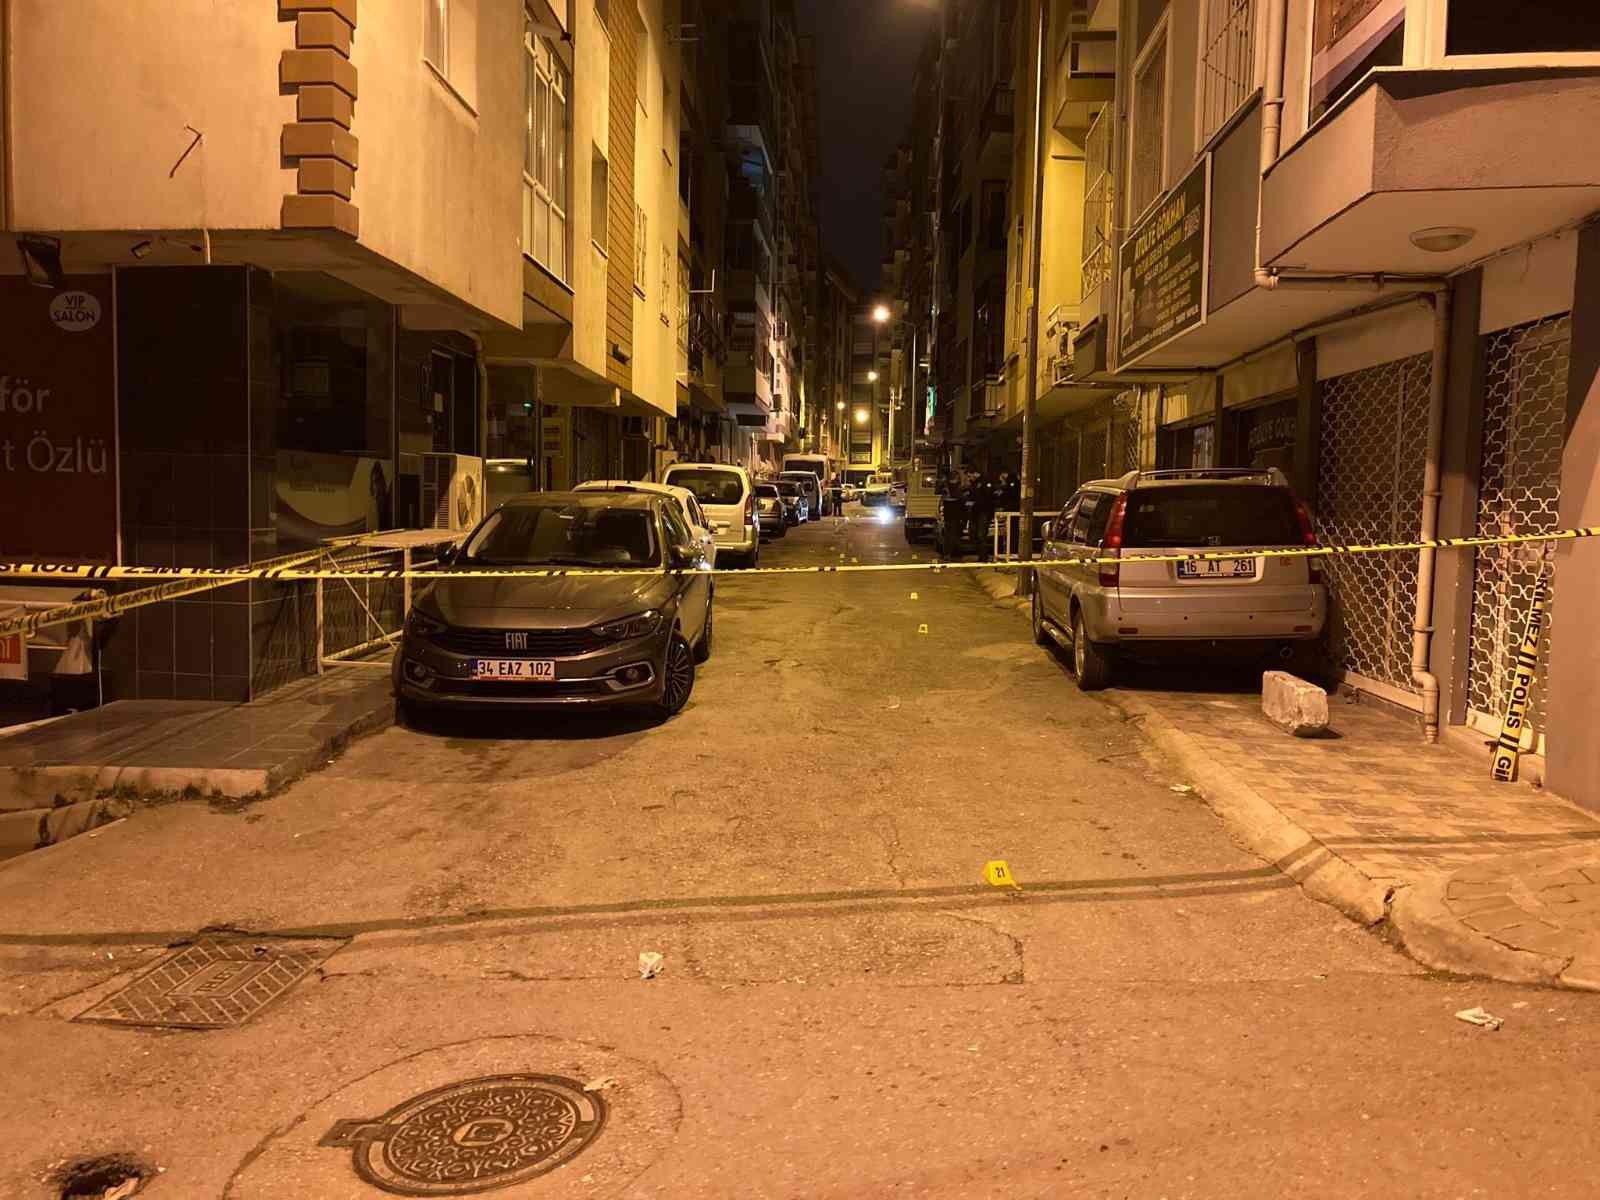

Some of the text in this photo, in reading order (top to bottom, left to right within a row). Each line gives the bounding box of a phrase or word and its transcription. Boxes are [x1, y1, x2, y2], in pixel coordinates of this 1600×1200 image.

[65, 295, 86, 309] VIP
[53, 310, 97, 322] SALON
[26, 429, 108, 473] Özlü
[1185, 558, 1253, 574] 16 AT 261
[505, 631, 529, 650] FIAT
[478, 661, 552, 676] 34 EAZ 102
